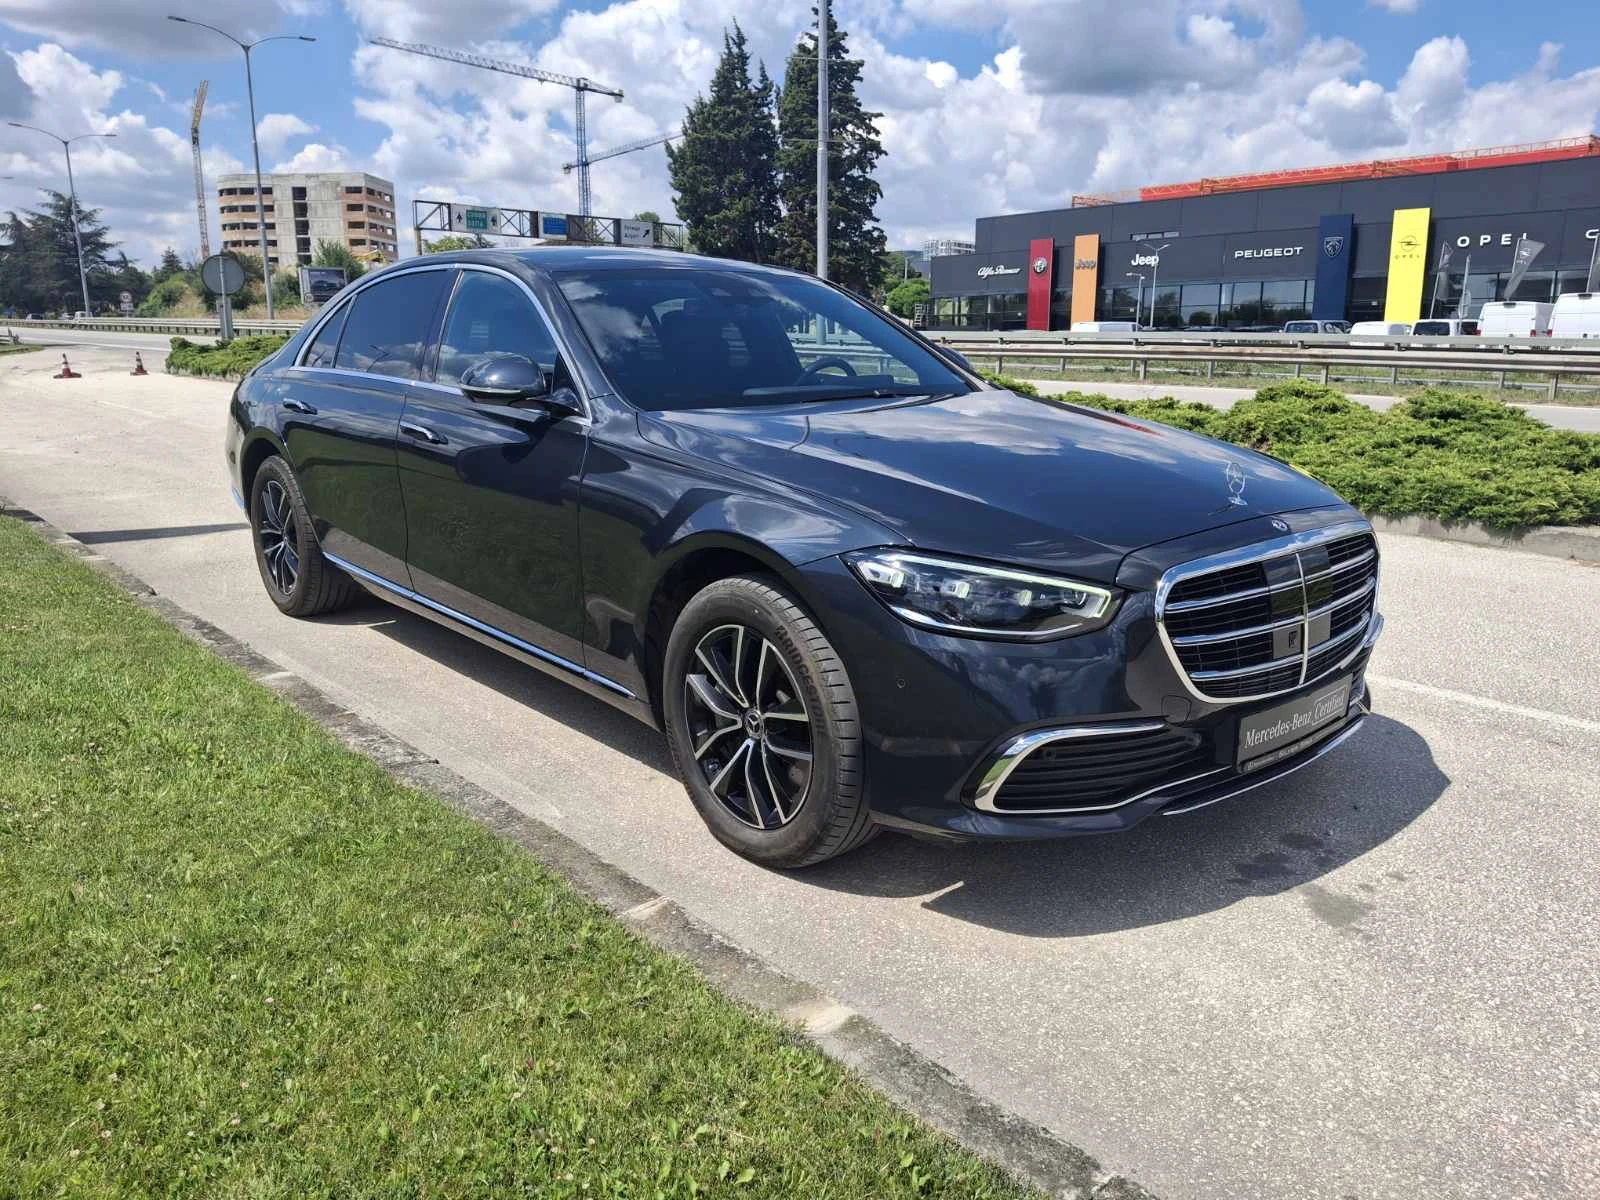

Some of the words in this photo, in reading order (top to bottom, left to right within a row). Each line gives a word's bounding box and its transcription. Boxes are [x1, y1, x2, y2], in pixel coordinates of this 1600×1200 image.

[1234, 246, 1304, 259] PEUGEOT
[1131, 253, 1160, 267] Jeep
[1244, 711, 1313, 749] Mercedes-Benz
[1313, 690, 1346, 720] Certified
